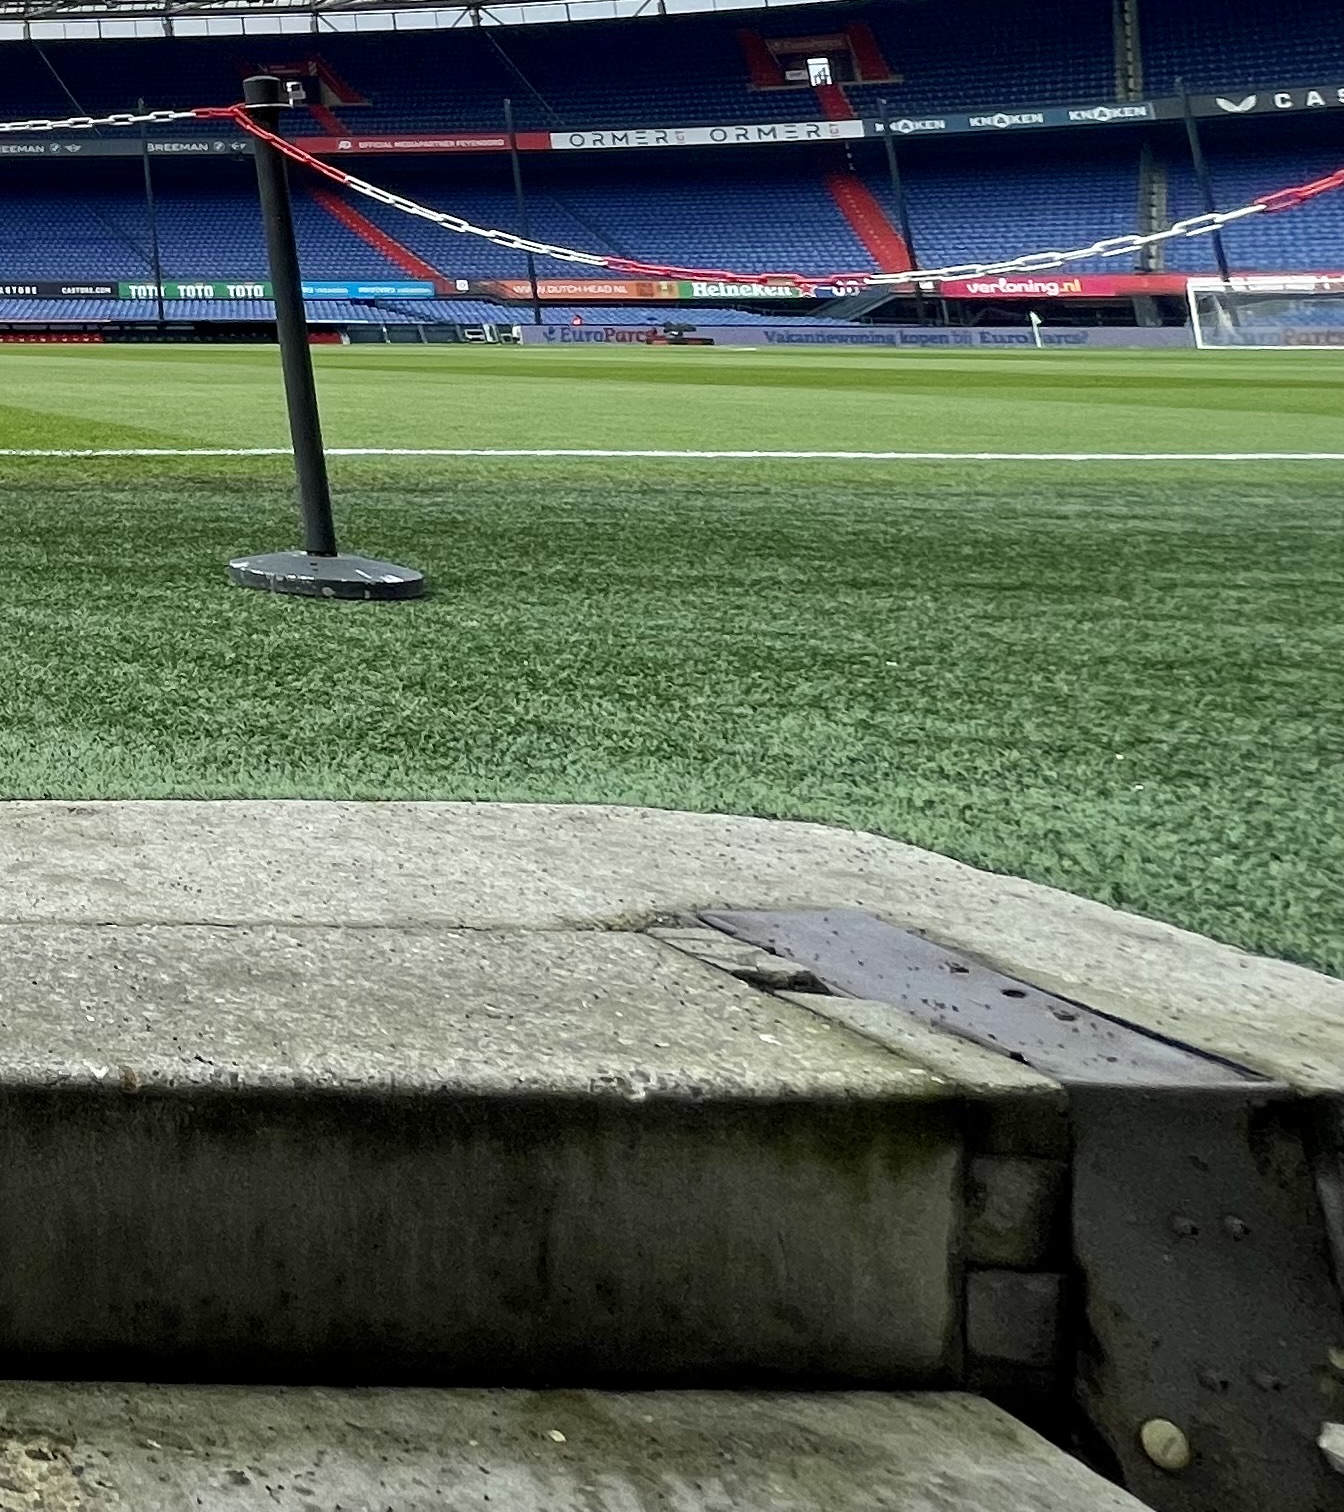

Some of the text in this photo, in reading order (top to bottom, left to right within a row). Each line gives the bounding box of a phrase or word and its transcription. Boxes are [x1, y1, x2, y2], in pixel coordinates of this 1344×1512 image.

[177, 285, 213, 298] TOTO
[227, 285, 264, 298] TOTO
[966, 278, 1082, 296] verloning.nl
